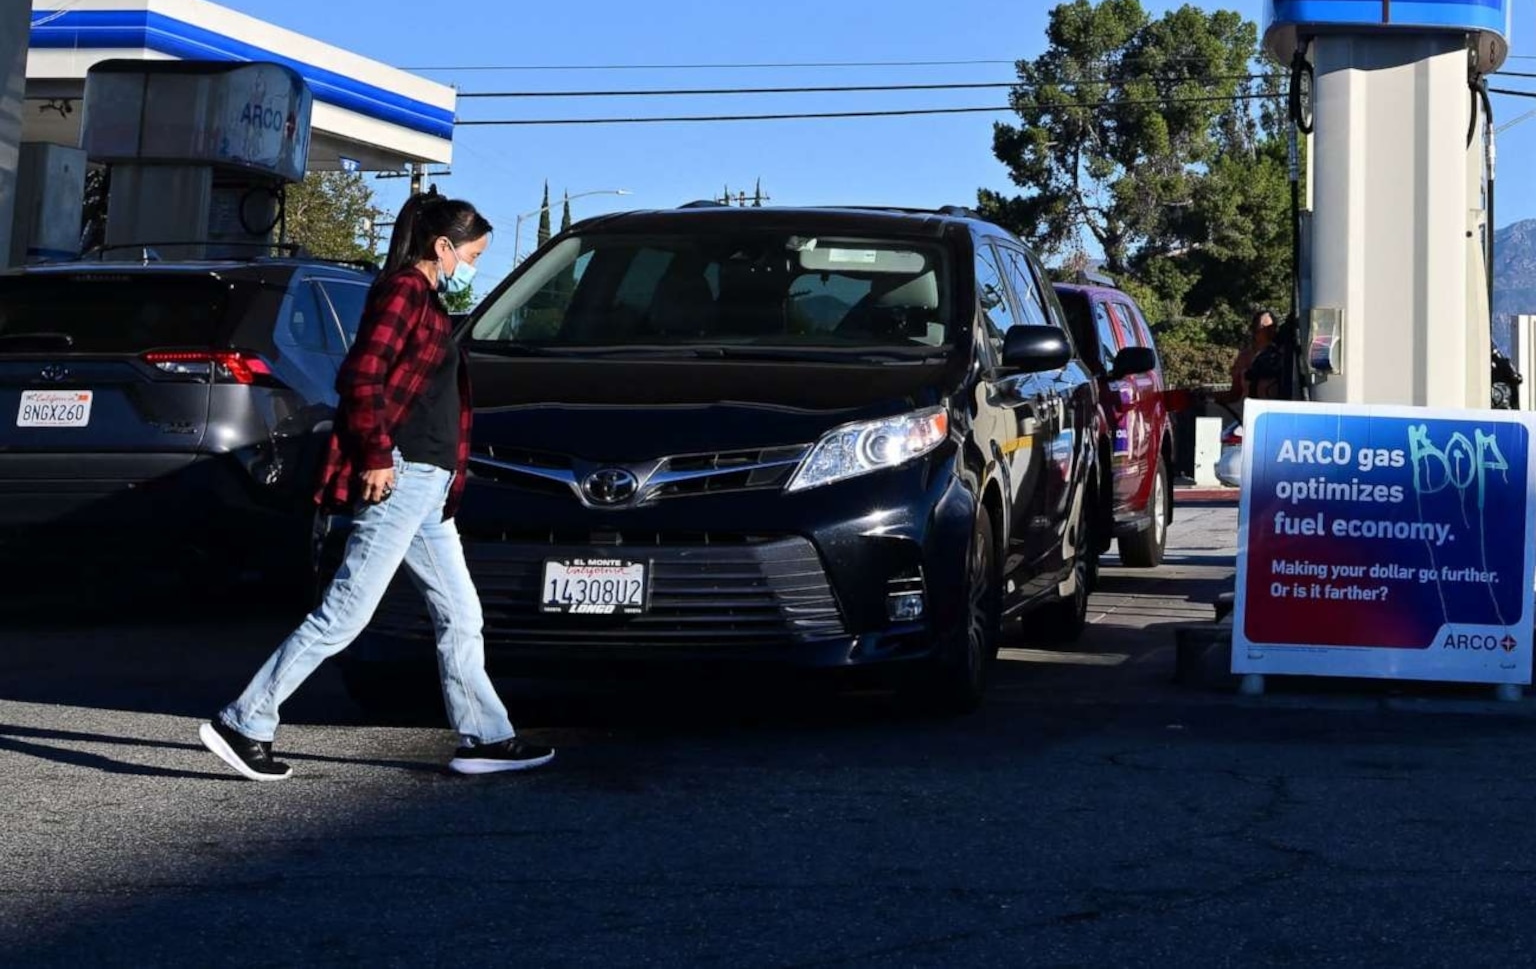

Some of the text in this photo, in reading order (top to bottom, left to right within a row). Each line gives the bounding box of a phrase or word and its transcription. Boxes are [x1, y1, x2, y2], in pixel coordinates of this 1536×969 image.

[240, 102, 283, 132] ARCO
[23, 404, 84, 421] 8NGX260
[1276, 440, 1405, 471] ARCO gas
[1275, 477, 1404, 504] optimizes
[1274, 511, 1455, 546] fuel economy.
[1272, 560, 1498, 583] Making your dollar go further.
[548, 579, 641, 605] 14308U2
[1270, 583, 1388, 601] Or is it farther?
[568, 605, 616, 614] LONGO
[1443, 634, 1497, 651] ARCO
